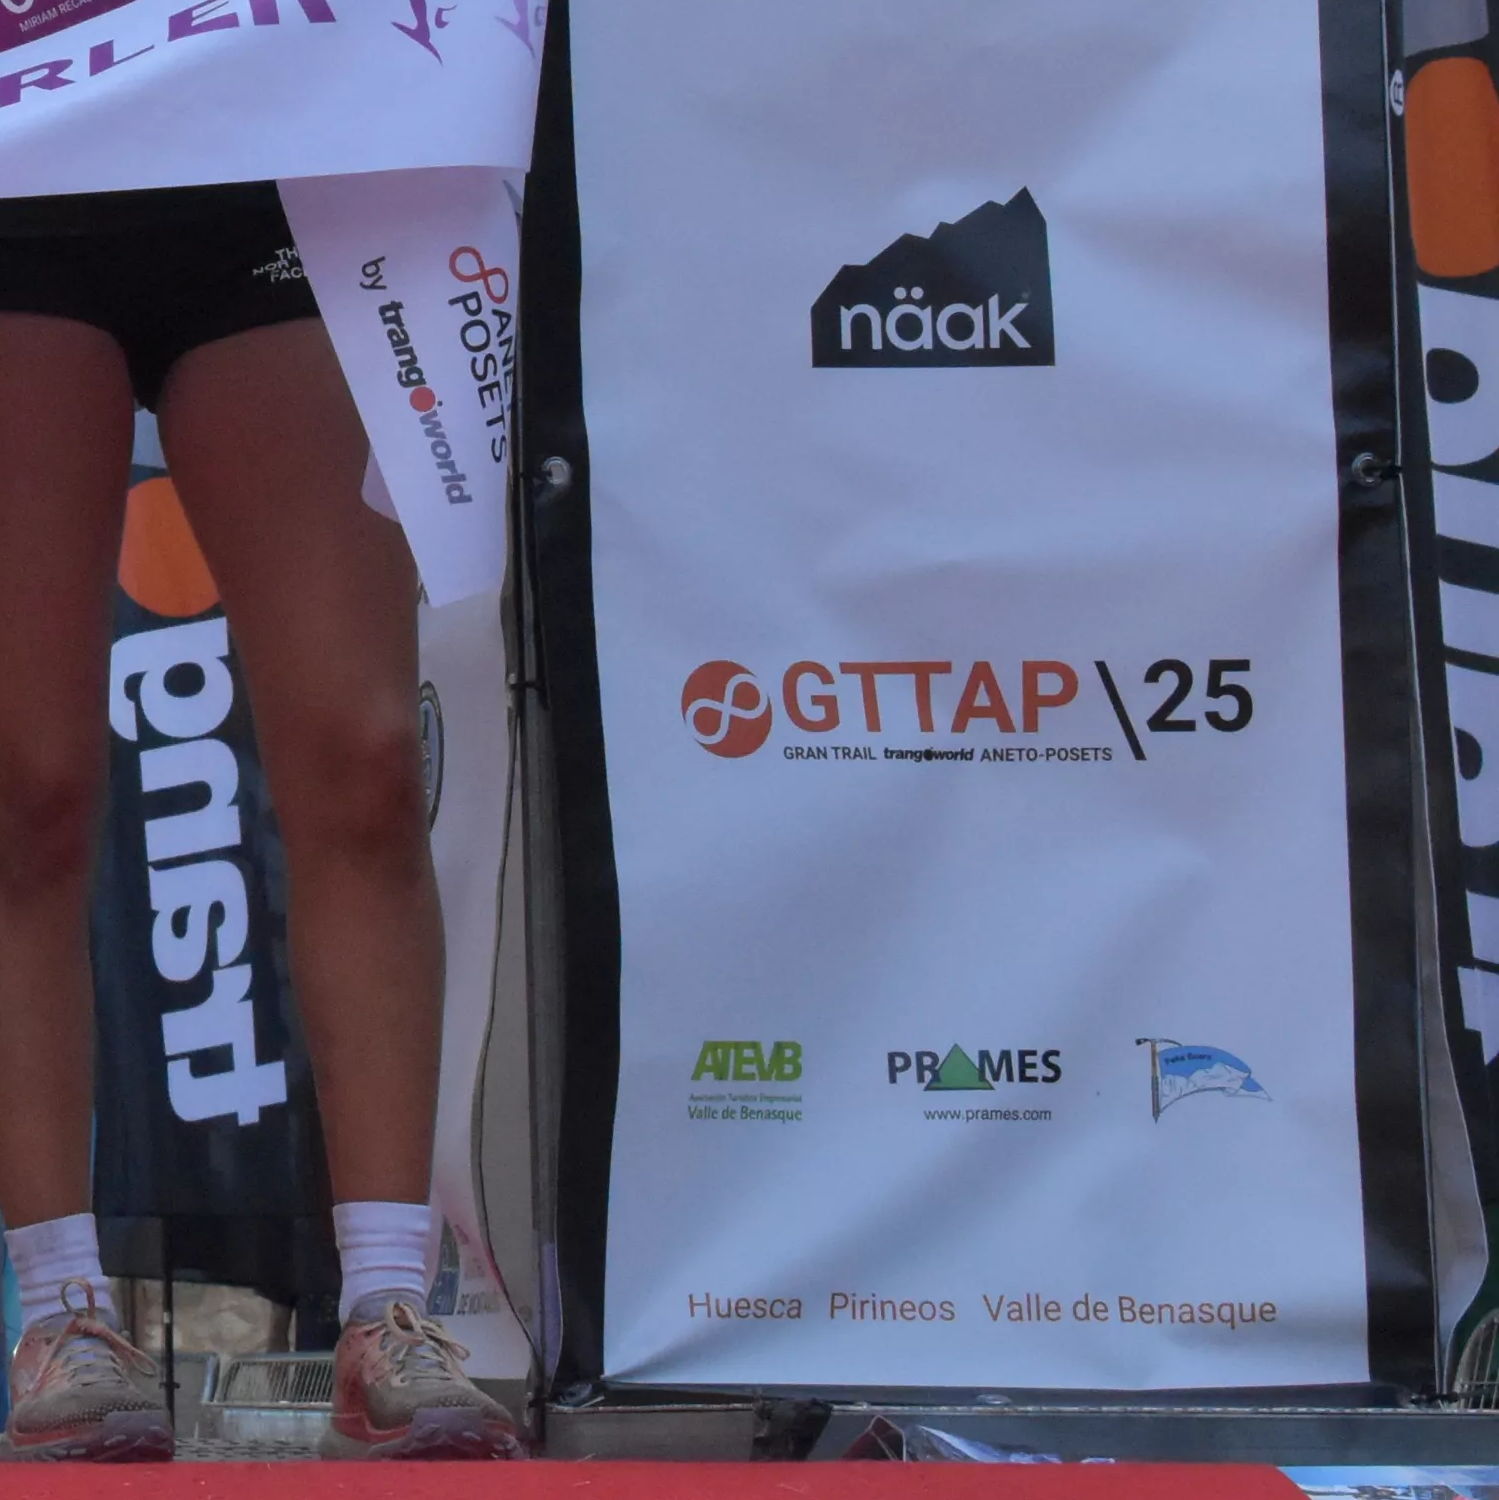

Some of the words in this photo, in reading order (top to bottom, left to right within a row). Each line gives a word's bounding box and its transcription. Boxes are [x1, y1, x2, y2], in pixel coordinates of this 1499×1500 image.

[19, 8, 58, 33] MIRIAM
[275, 246, 298, 260] TH
[270, 266, 303, 282] FAC
[359, 256, 388, 290] by
[839, 286, 1031, 351] näak
[448, 291, 507, 464] POSETS
[783, 746, 826, 760] GRAN
[831, 746, 877, 761] TRAIL
[980, 747, 1112, 764] ANETO-POSETS
[688, 1105, 718, 1119] Valle
[721, 1105, 737, 1120] de
[740, 1105, 802, 1124] Benasque
[924, 1106, 1051, 1123] www.prames.com
[688, 1291, 803, 1320] Huesca
[829, 1292, 955, 1322] Pirineos
[983, 1293, 1061, 1323] Valle
[1073, 1293, 1109, 1323] de
[1120, 1297, 1276, 1331] Benasque
